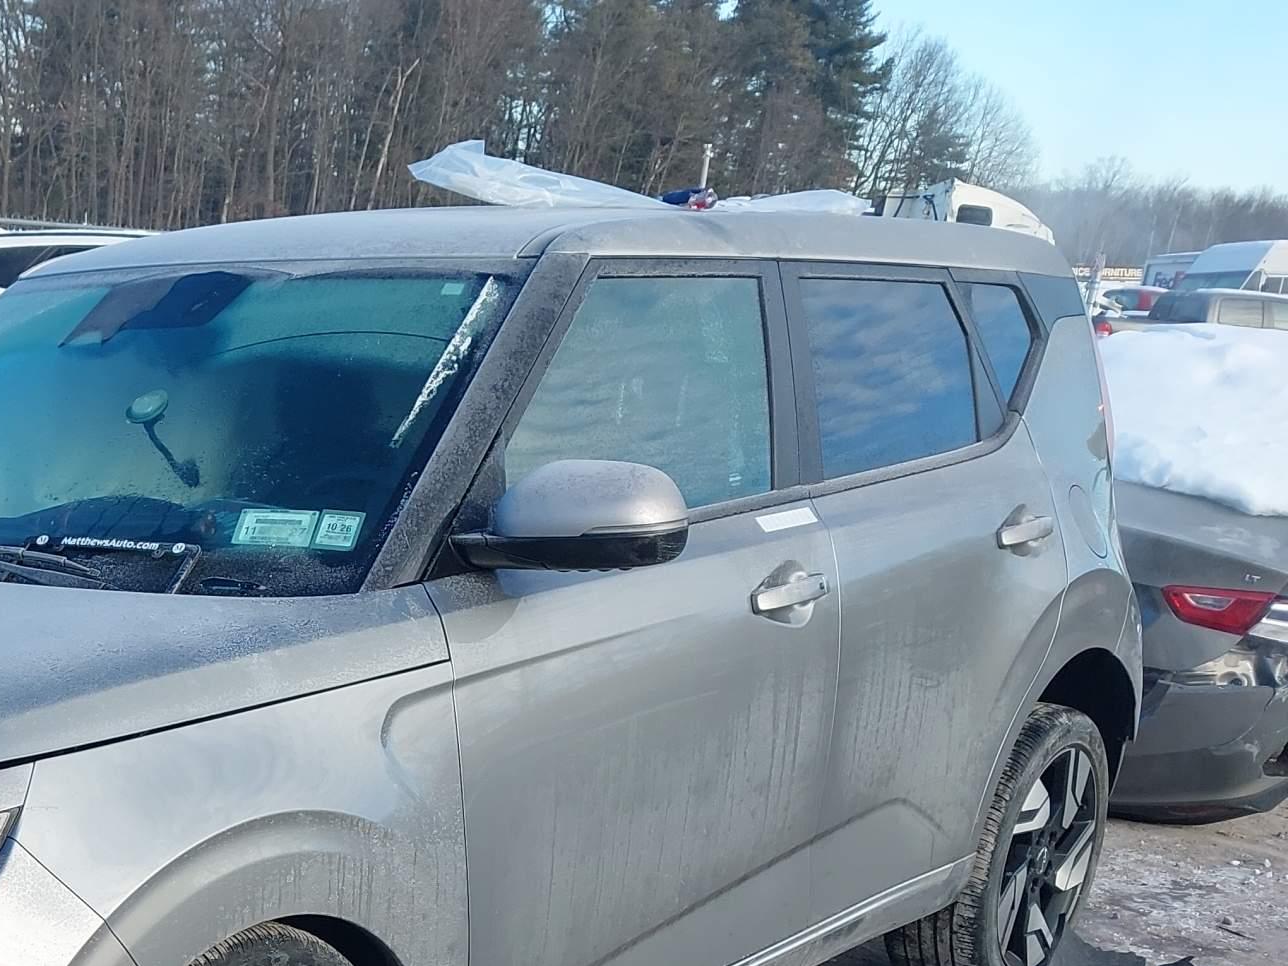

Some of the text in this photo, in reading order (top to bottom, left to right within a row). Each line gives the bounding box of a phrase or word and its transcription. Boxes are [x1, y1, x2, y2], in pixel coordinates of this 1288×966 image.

[1099, 267, 1143, 277] RNITURE
[326, 522, 353, 533] 10 26
[61, 536, 159, 550] MatthewsAuto.com
